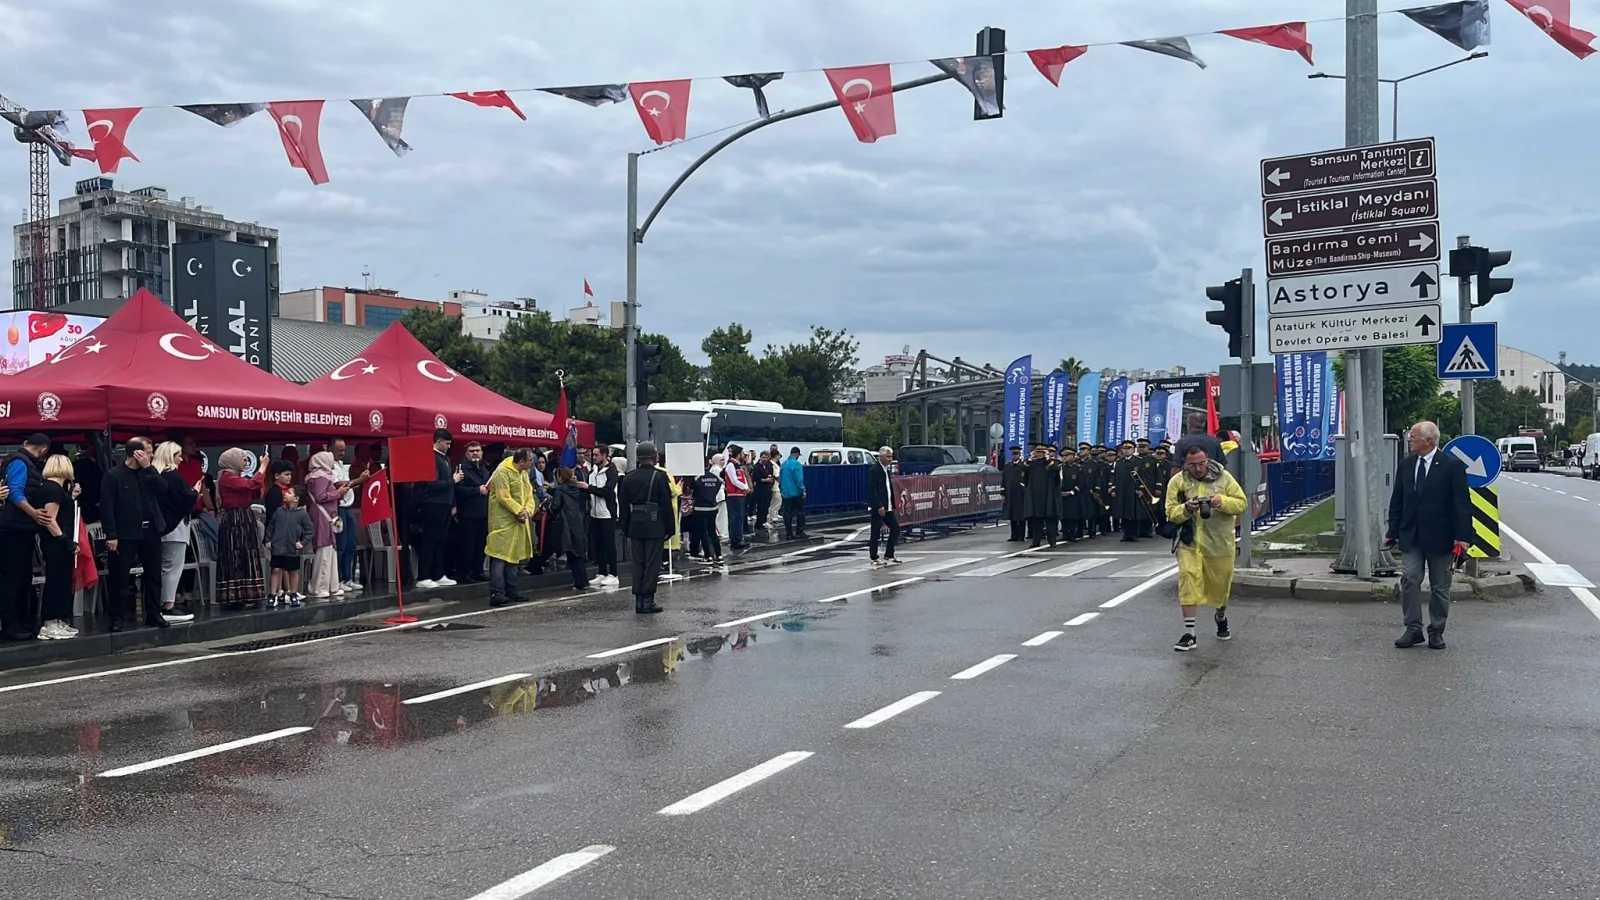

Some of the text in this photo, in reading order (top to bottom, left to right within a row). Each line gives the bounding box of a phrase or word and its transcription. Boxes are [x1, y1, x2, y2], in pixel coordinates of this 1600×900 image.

[1310, 147, 1406, 166] Samsun Tanıtım
[1360, 156, 1407, 170] Merkezi
[1329, 175, 1350, 184] Tourism
[1353, 170, 1384, 181] Information
[1387, 168, 1406, 177] Center)
[1297, 190, 1429, 214] İstiklal Meydanı
[1351, 204, 1429, 222] (İstiklal Square)
[1272, 232, 1398, 255] Bandırma Gemi
[1273, 258, 1313, 270] Müze
[1314, 256, 1327, 265] (The
[1274, 280, 1389, 305] Astorya
[68, 324, 82, 334] 30
[229, 300, 246, 361] LAL
[1275, 314, 1408, 332] Atatürk Kültür Merkezi
[1276, 338, 1311, 347] Devlet
[1316, 334, 1349, 346] Opera
[1373, 330, 1409, 340] Balesi
[1294, 354, 1303, 413] FEDERASYONU
[1313, 364, 1321, 417] FEDERASYONU
[197, 405, 352, 426] SAMSUN BÜYÜKŞEHİR BELEDİYESİ
[1055, 384, 1063, 431] FEDERASYONU
[1283, 387, 1293, 424] TÜRKİYE
[461, 423, 487, 434] SAMSUN
[489, 424, 526, 437] BÜYÜKŞEHİR
[1083, 396, 1092, 444] SHIMANO
